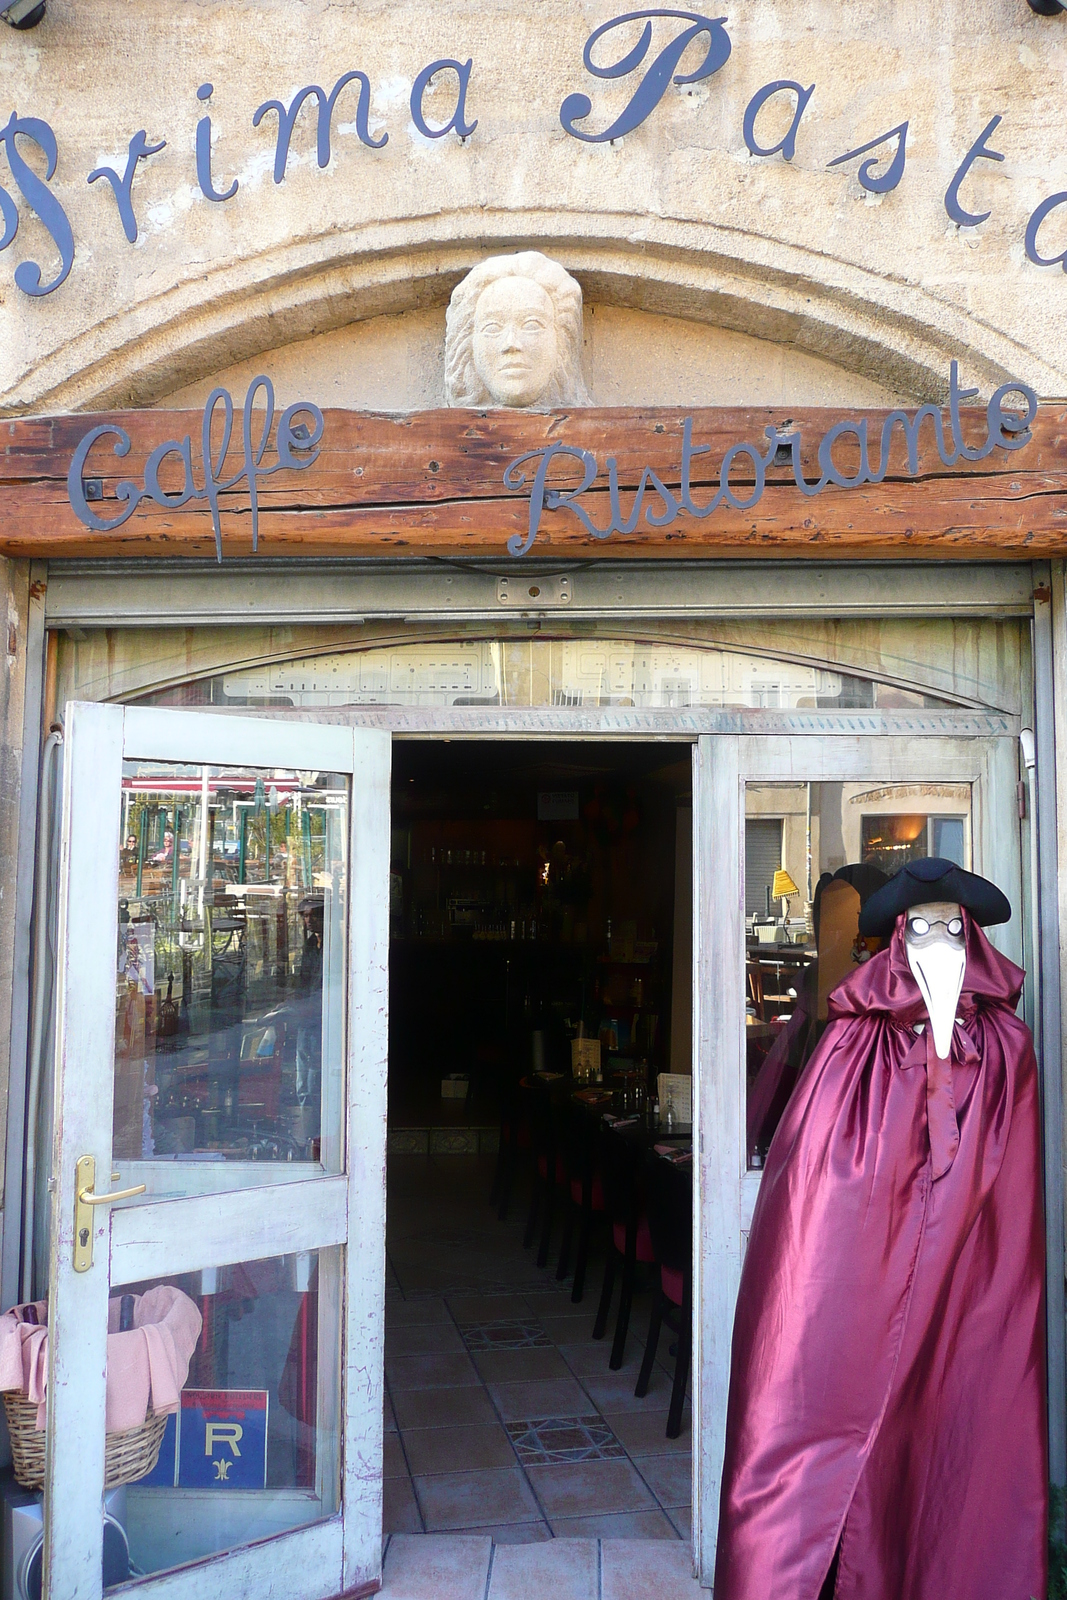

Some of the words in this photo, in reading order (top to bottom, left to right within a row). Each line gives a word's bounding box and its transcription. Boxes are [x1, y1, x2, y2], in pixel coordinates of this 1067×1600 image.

[560, 8, 1067, 274] Pasta
[67, 374, 324, 563] Caffe
[503, 360, 1038, 557] Ristorante
[204, 1422, 243, 1457] R
